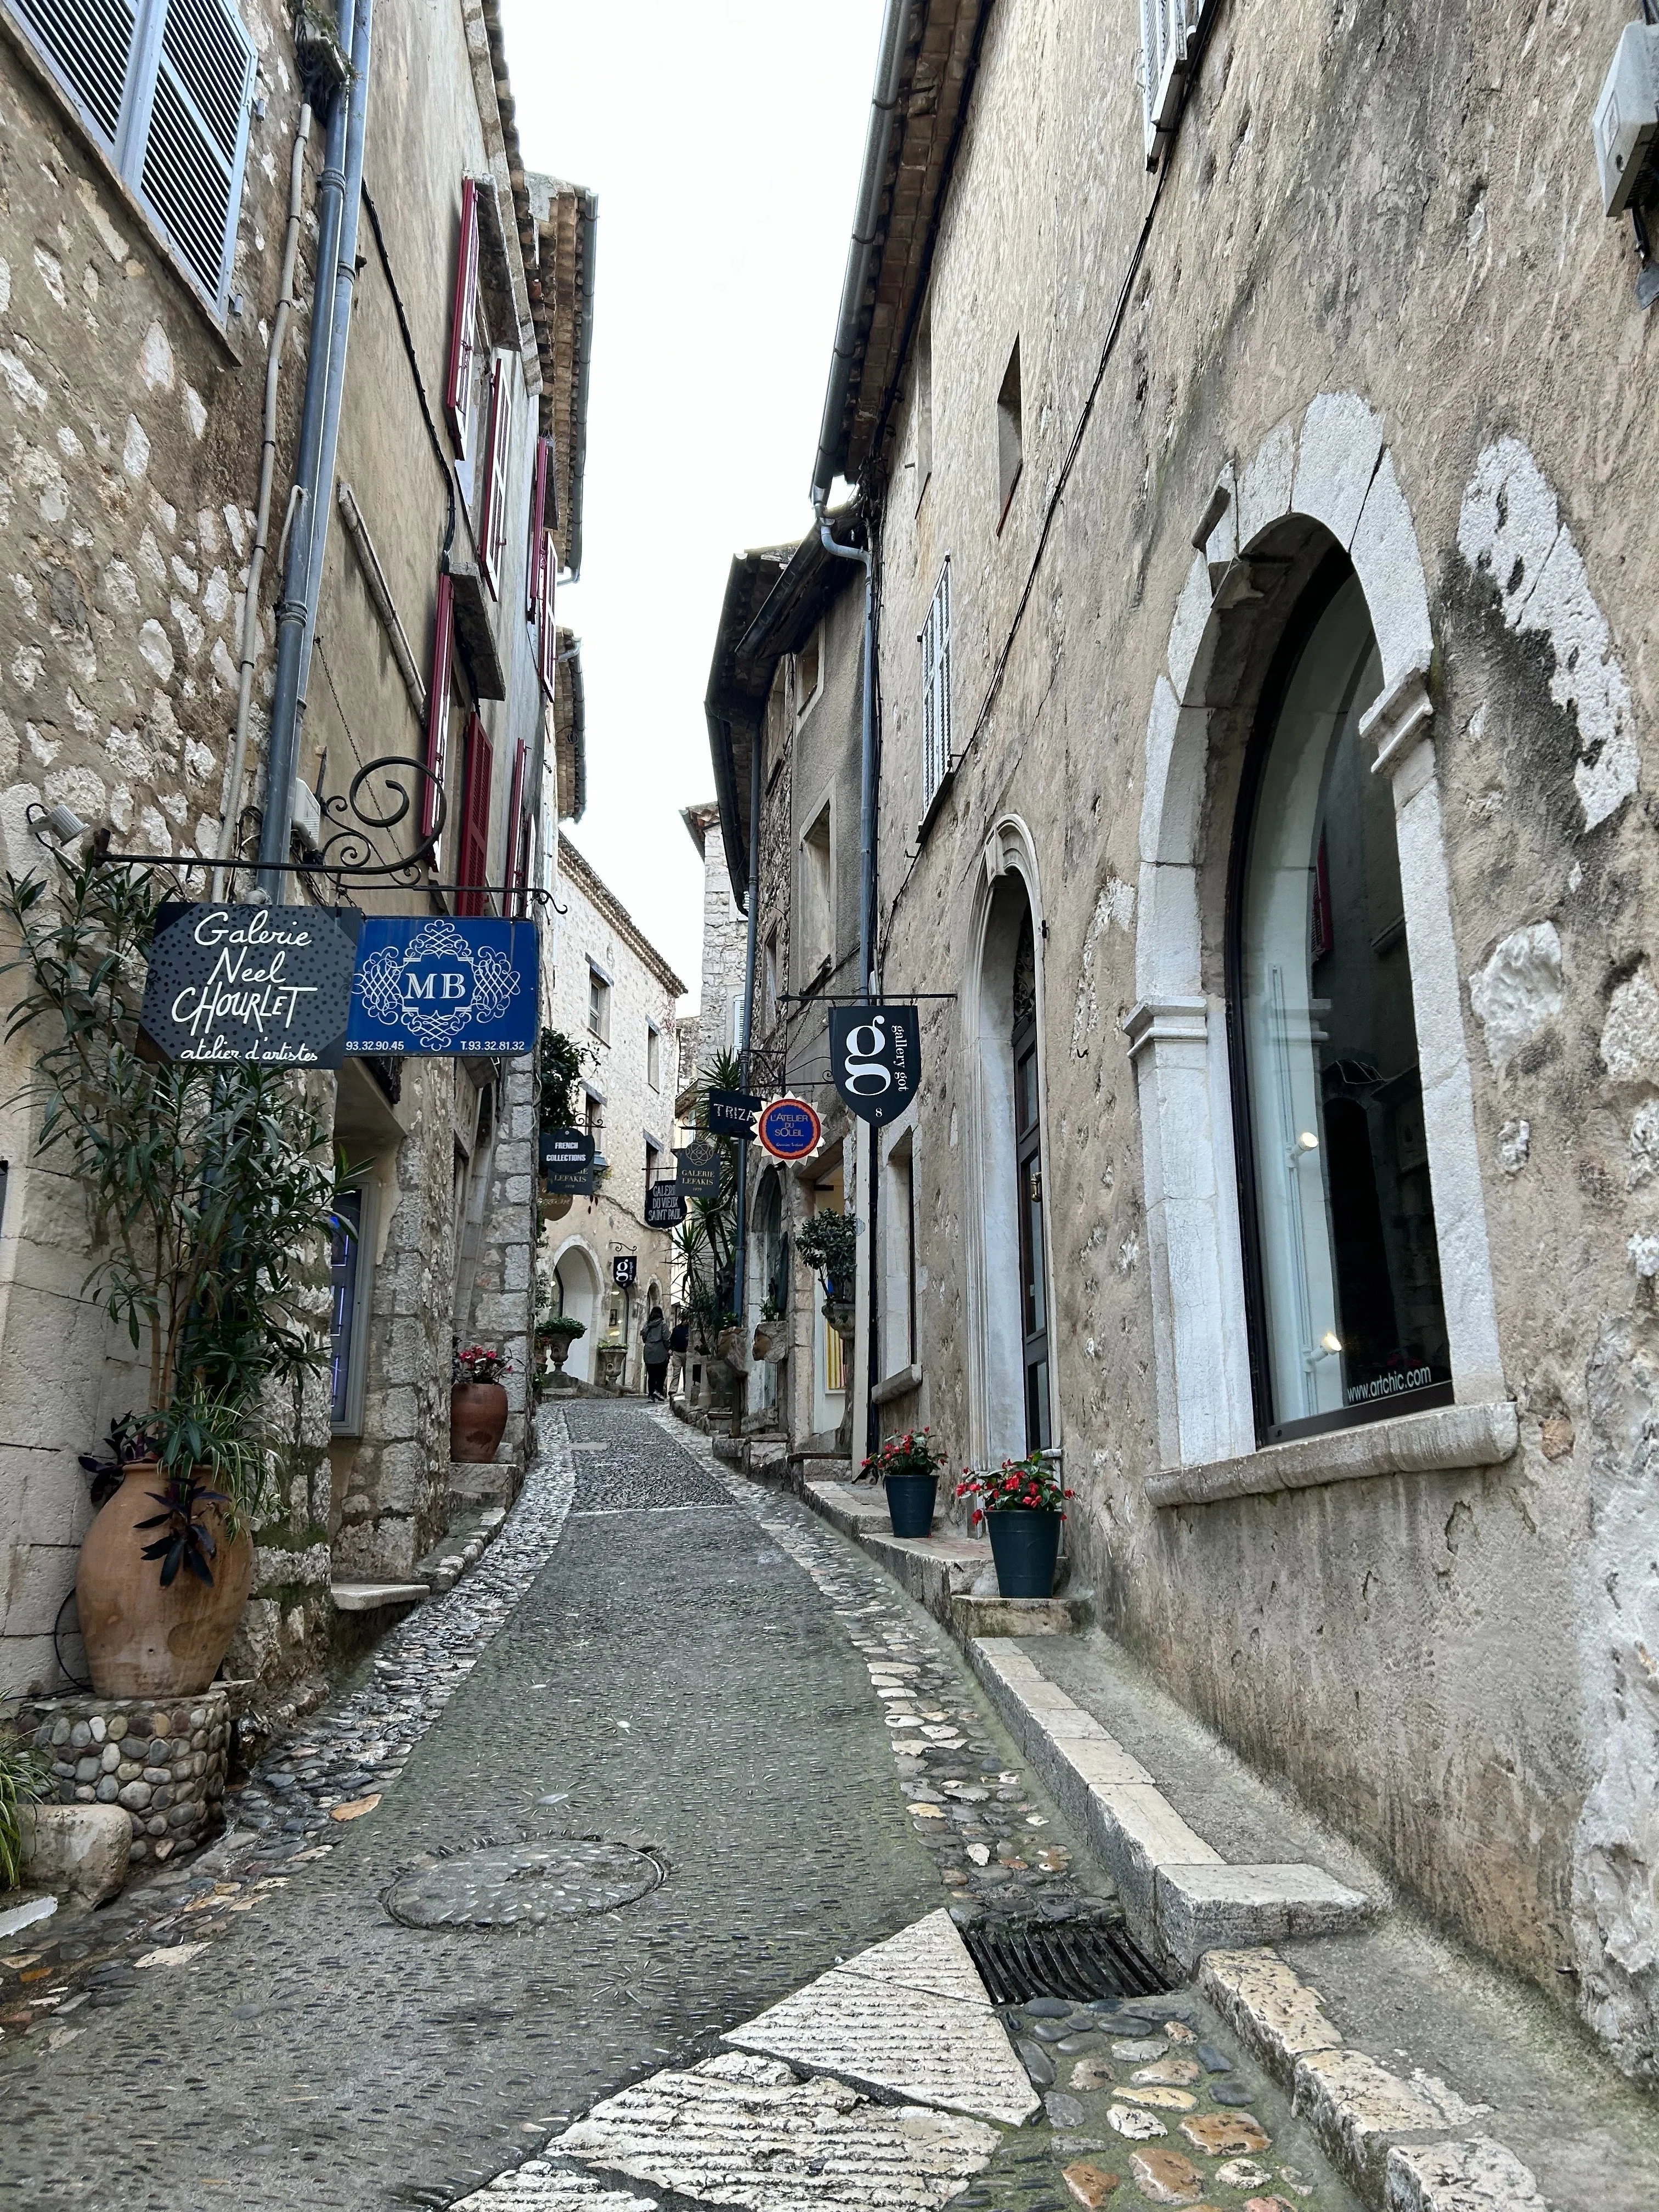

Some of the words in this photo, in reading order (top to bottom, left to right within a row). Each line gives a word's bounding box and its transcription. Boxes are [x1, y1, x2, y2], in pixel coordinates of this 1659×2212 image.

[194, 910, 312, 946] Galerie
[207, 946, 286, 985] Neel
[404, 973, 466, 999] MB
[171, 981, 318, 1036] CHOURLET
[180, 1034, 241, 1060] atelier
[245, 1036, 318, 1062] d'artistes
[460, 1041, 525, 1051] T.93.32.81.32
[891, 1025, 907, 1068] gallery
[845, 1015, 891, 1096] g
[894, 1072, 909, 1092] got
[876, 1108, 883, 1118] 8
[775, 1127, 804, 1137] SOLEIL
[555, 1142, 579, 1150] FRENCH
[554, 1175, 587, 1183] LEFAKIS
[681, 1170, 715, 1178] GALERIE
[682, 1177, 714, 1186] LEFAKIS
[653, 1184, 675, 1197] GALERI
[652, 1197, 661, 1209] DU
[661, 1197, 679, 1208] VIEUX
[648, 1209, 668, 1221] SAINT
[668, 1208, 683, 1220] PAUL
[1347, 1366, 1432, 1403] www.artchic.com
